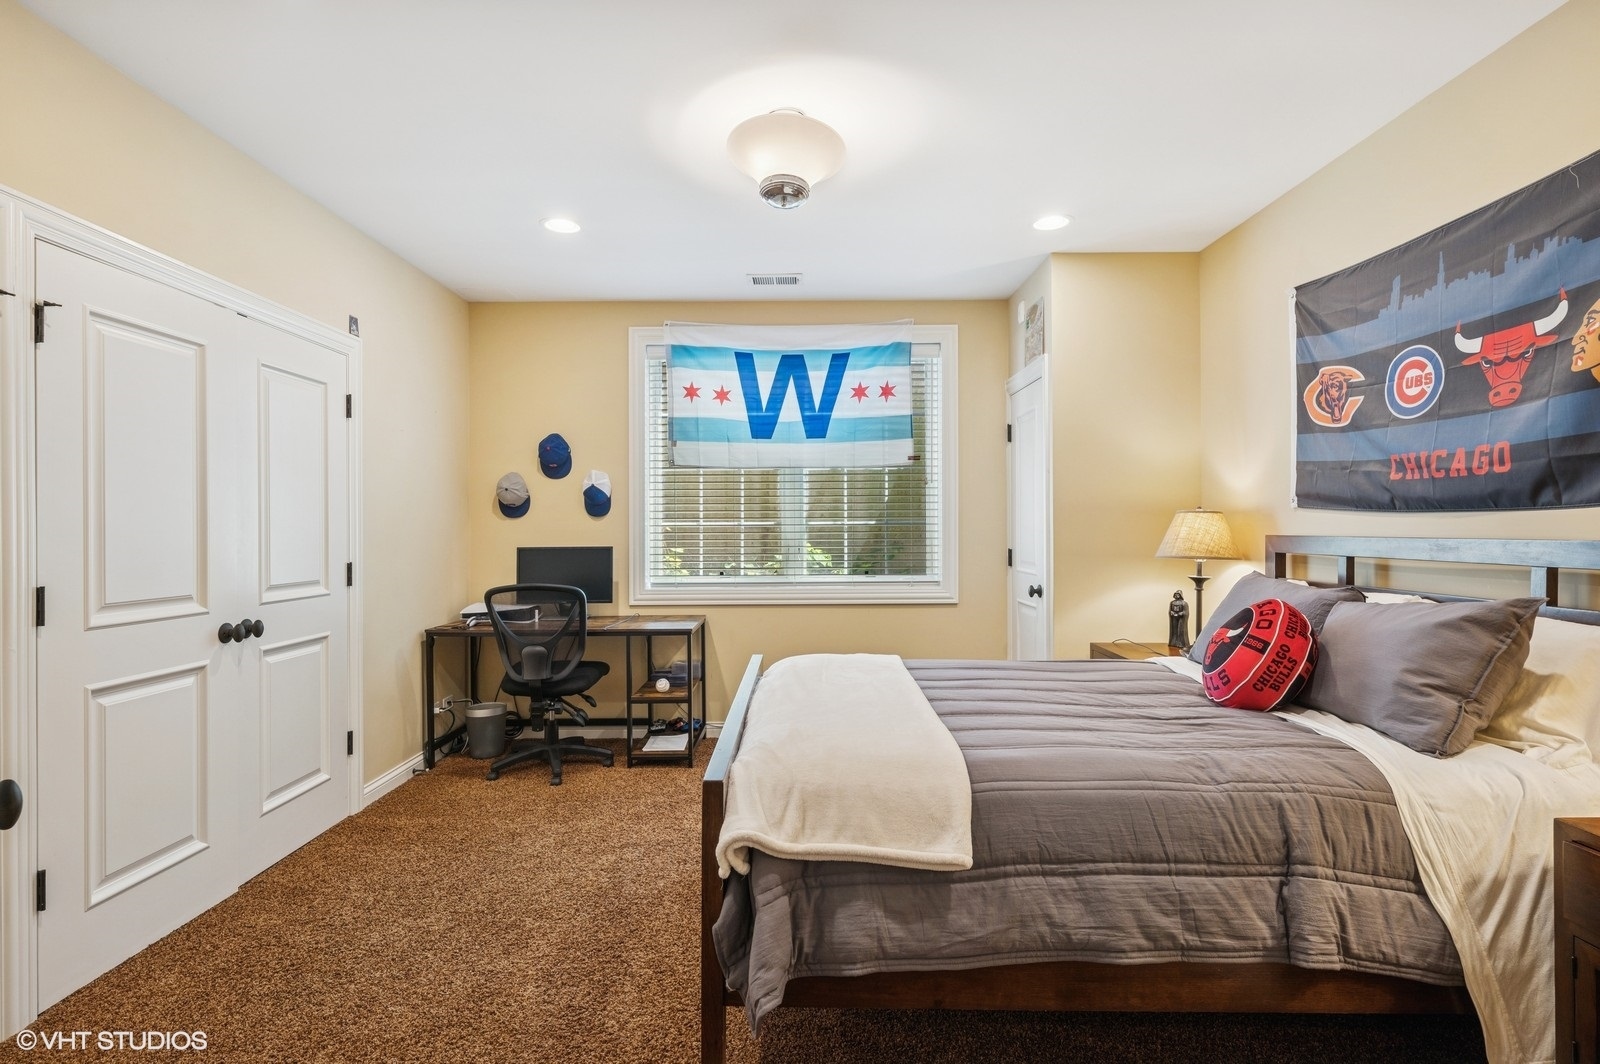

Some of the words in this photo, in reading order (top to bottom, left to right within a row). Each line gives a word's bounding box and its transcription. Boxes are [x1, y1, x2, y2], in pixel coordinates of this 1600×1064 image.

[734, 351, 851, 440] W
[1395, 358, 1434, 406] CUBS
[1389, 440, 1512, 481] CHICAGO
[1252, 643, 1291, 693] CHICAGO
[1268, 656, 1298, 693] BULLS
